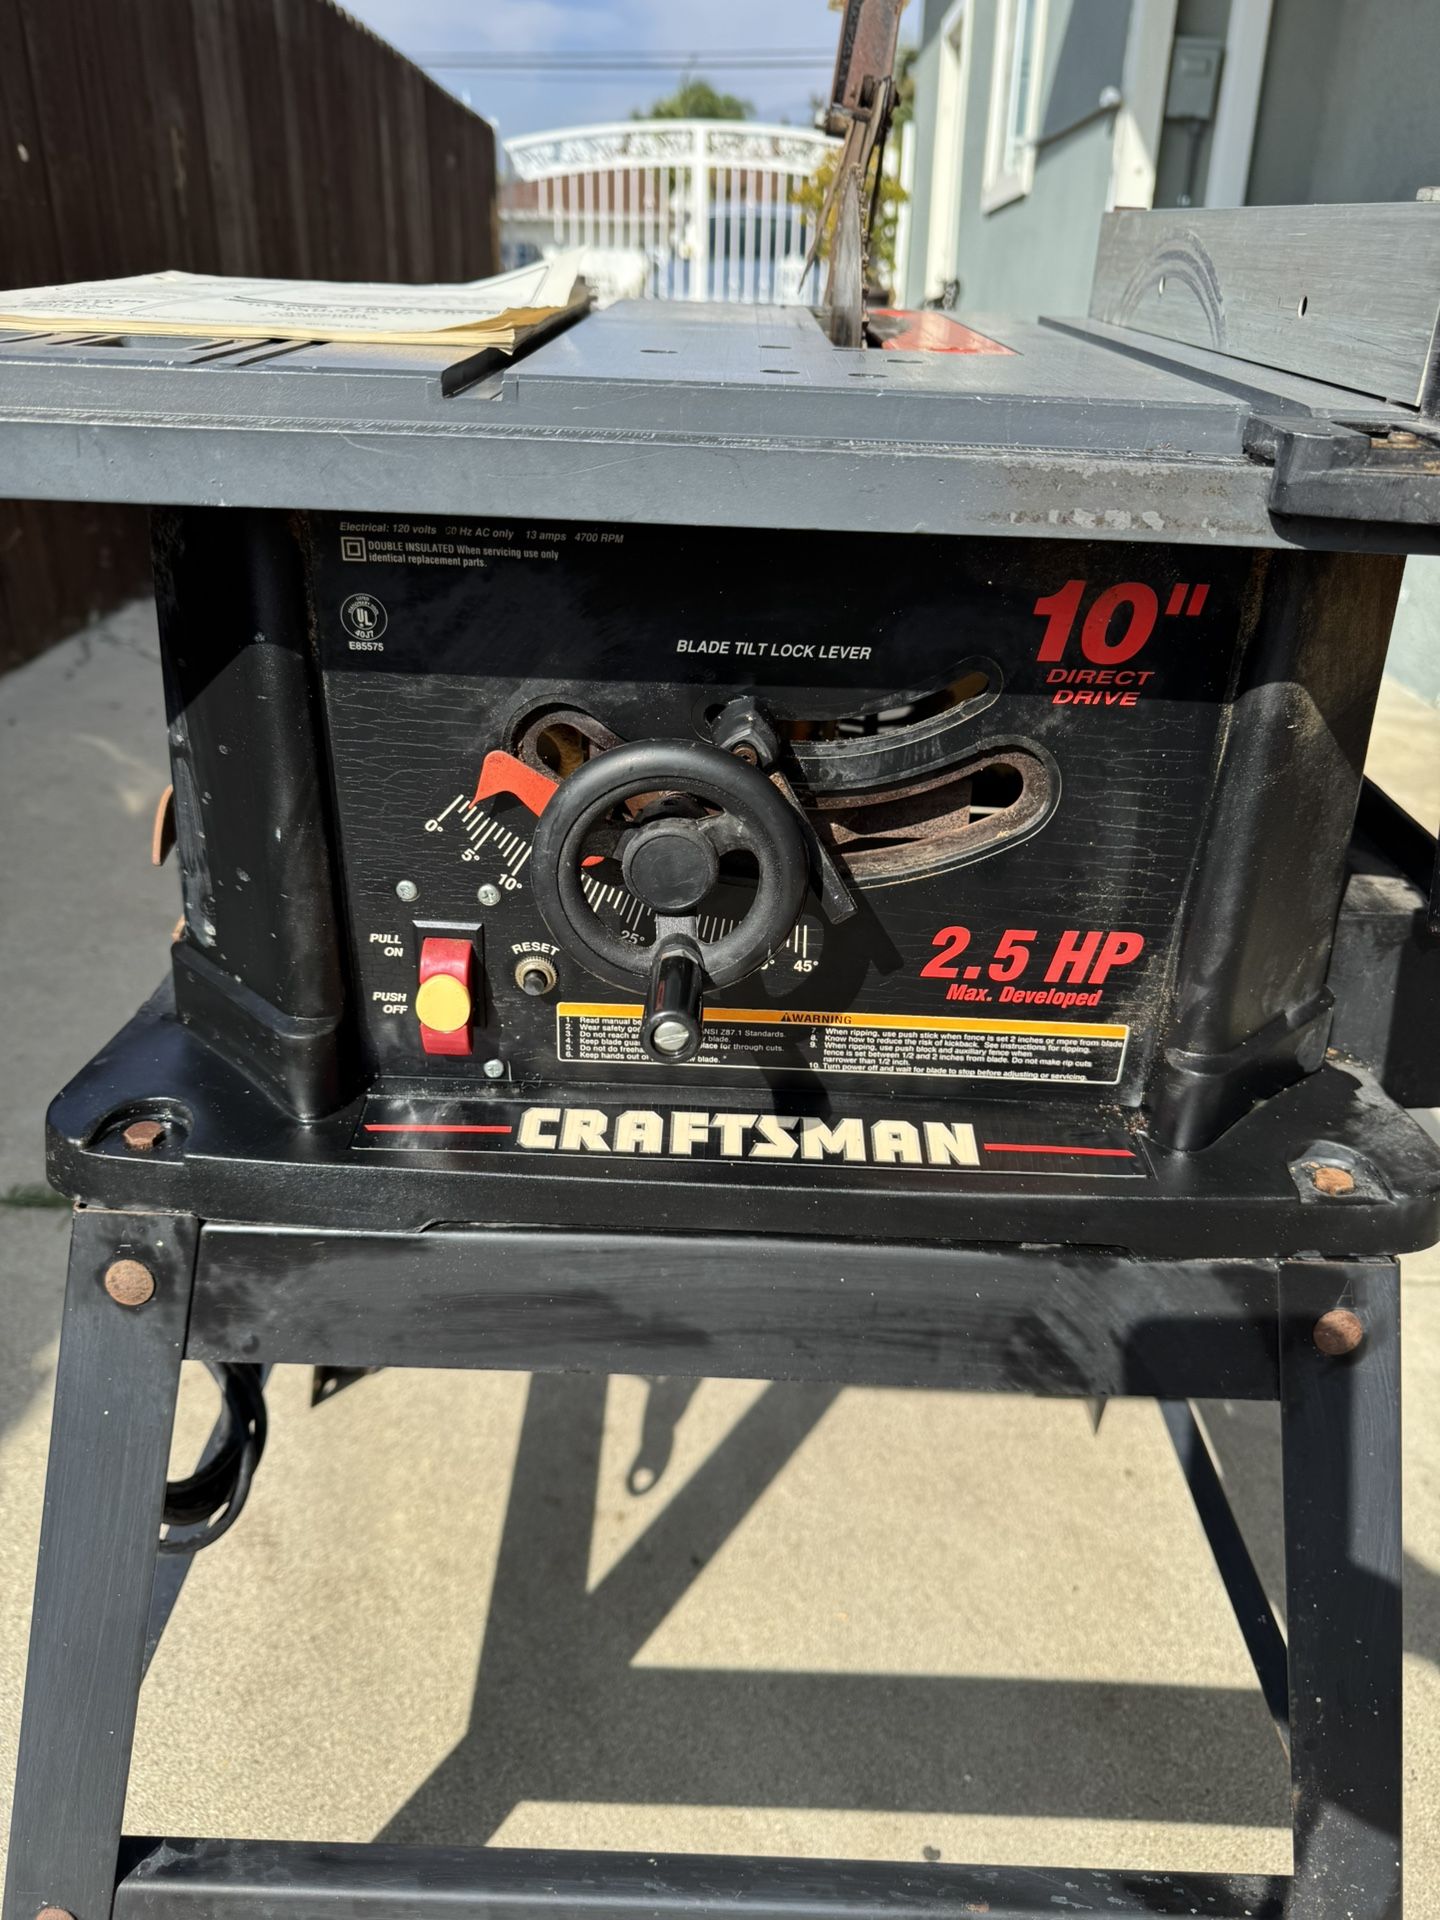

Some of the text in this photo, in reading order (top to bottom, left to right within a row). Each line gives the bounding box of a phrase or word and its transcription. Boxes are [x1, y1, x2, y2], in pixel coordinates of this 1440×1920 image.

[340, 522, 389, 532] Electrical:
[393, 524, 410, 533] 120
[413, 525, 437, 534] volts
[460, 527, 472, 536] Hz
[475, 528, 490, 537] AC
[493, 530, 514, 540] only
[526, 531, 536, 539] 13
[539, 532, 567, 543] amps
[574, 533, 598, 543] 4700
[601, 534, 624, 544] RPM
[368, 541, 559, 560] DOUBLE INSULATED When servicing use only
[368, 553, 487, 568] identical replacement parts.
[357, 608, 373, 626] UL
[349, 641, 384, 652] E85575
[676, 640, 872, 660] BLADE TILT LOCK LEVER
[1046, 669, 1155, 686] DIRECT
[1052, 690, 1140, 706] DRIVE
[498, 873, 523, 891] 10°
[369, 934, 402, 944] PULL
[384, 947, 403, 957] ON
[511, 942, 560, 956] RESET
[920, 926, 1144, 984] 2.5 HP
[793, 960, 819, 972] 45°
[372, 992, 407, 1002] PUSH
[946, 984, 1103, 1009] Max. Developed
[383, 1005, 408, 1014] OFF
[792, 1014, 852, 1024] WARNING
[920, 1032, 938, 1040] stick
[1018, 1036, 1044, 1044] inches
[877, 1037, 903, 1045] reduce
[944, 1040, 979, 1048] kickback.
[1000, 1043, 1046, 1051] instructions
[1061, 1046, 1091, 1054] ripping.
[955, 1048, 986, 1056] auxiliary
[580, 1052, 599, 1060] Keep
[977, 1069, 1001, 1077] before
[1003, 1070, 1039, 1079] adjusting
[516, 1107, 980, 1166] CRAFTSMAN
